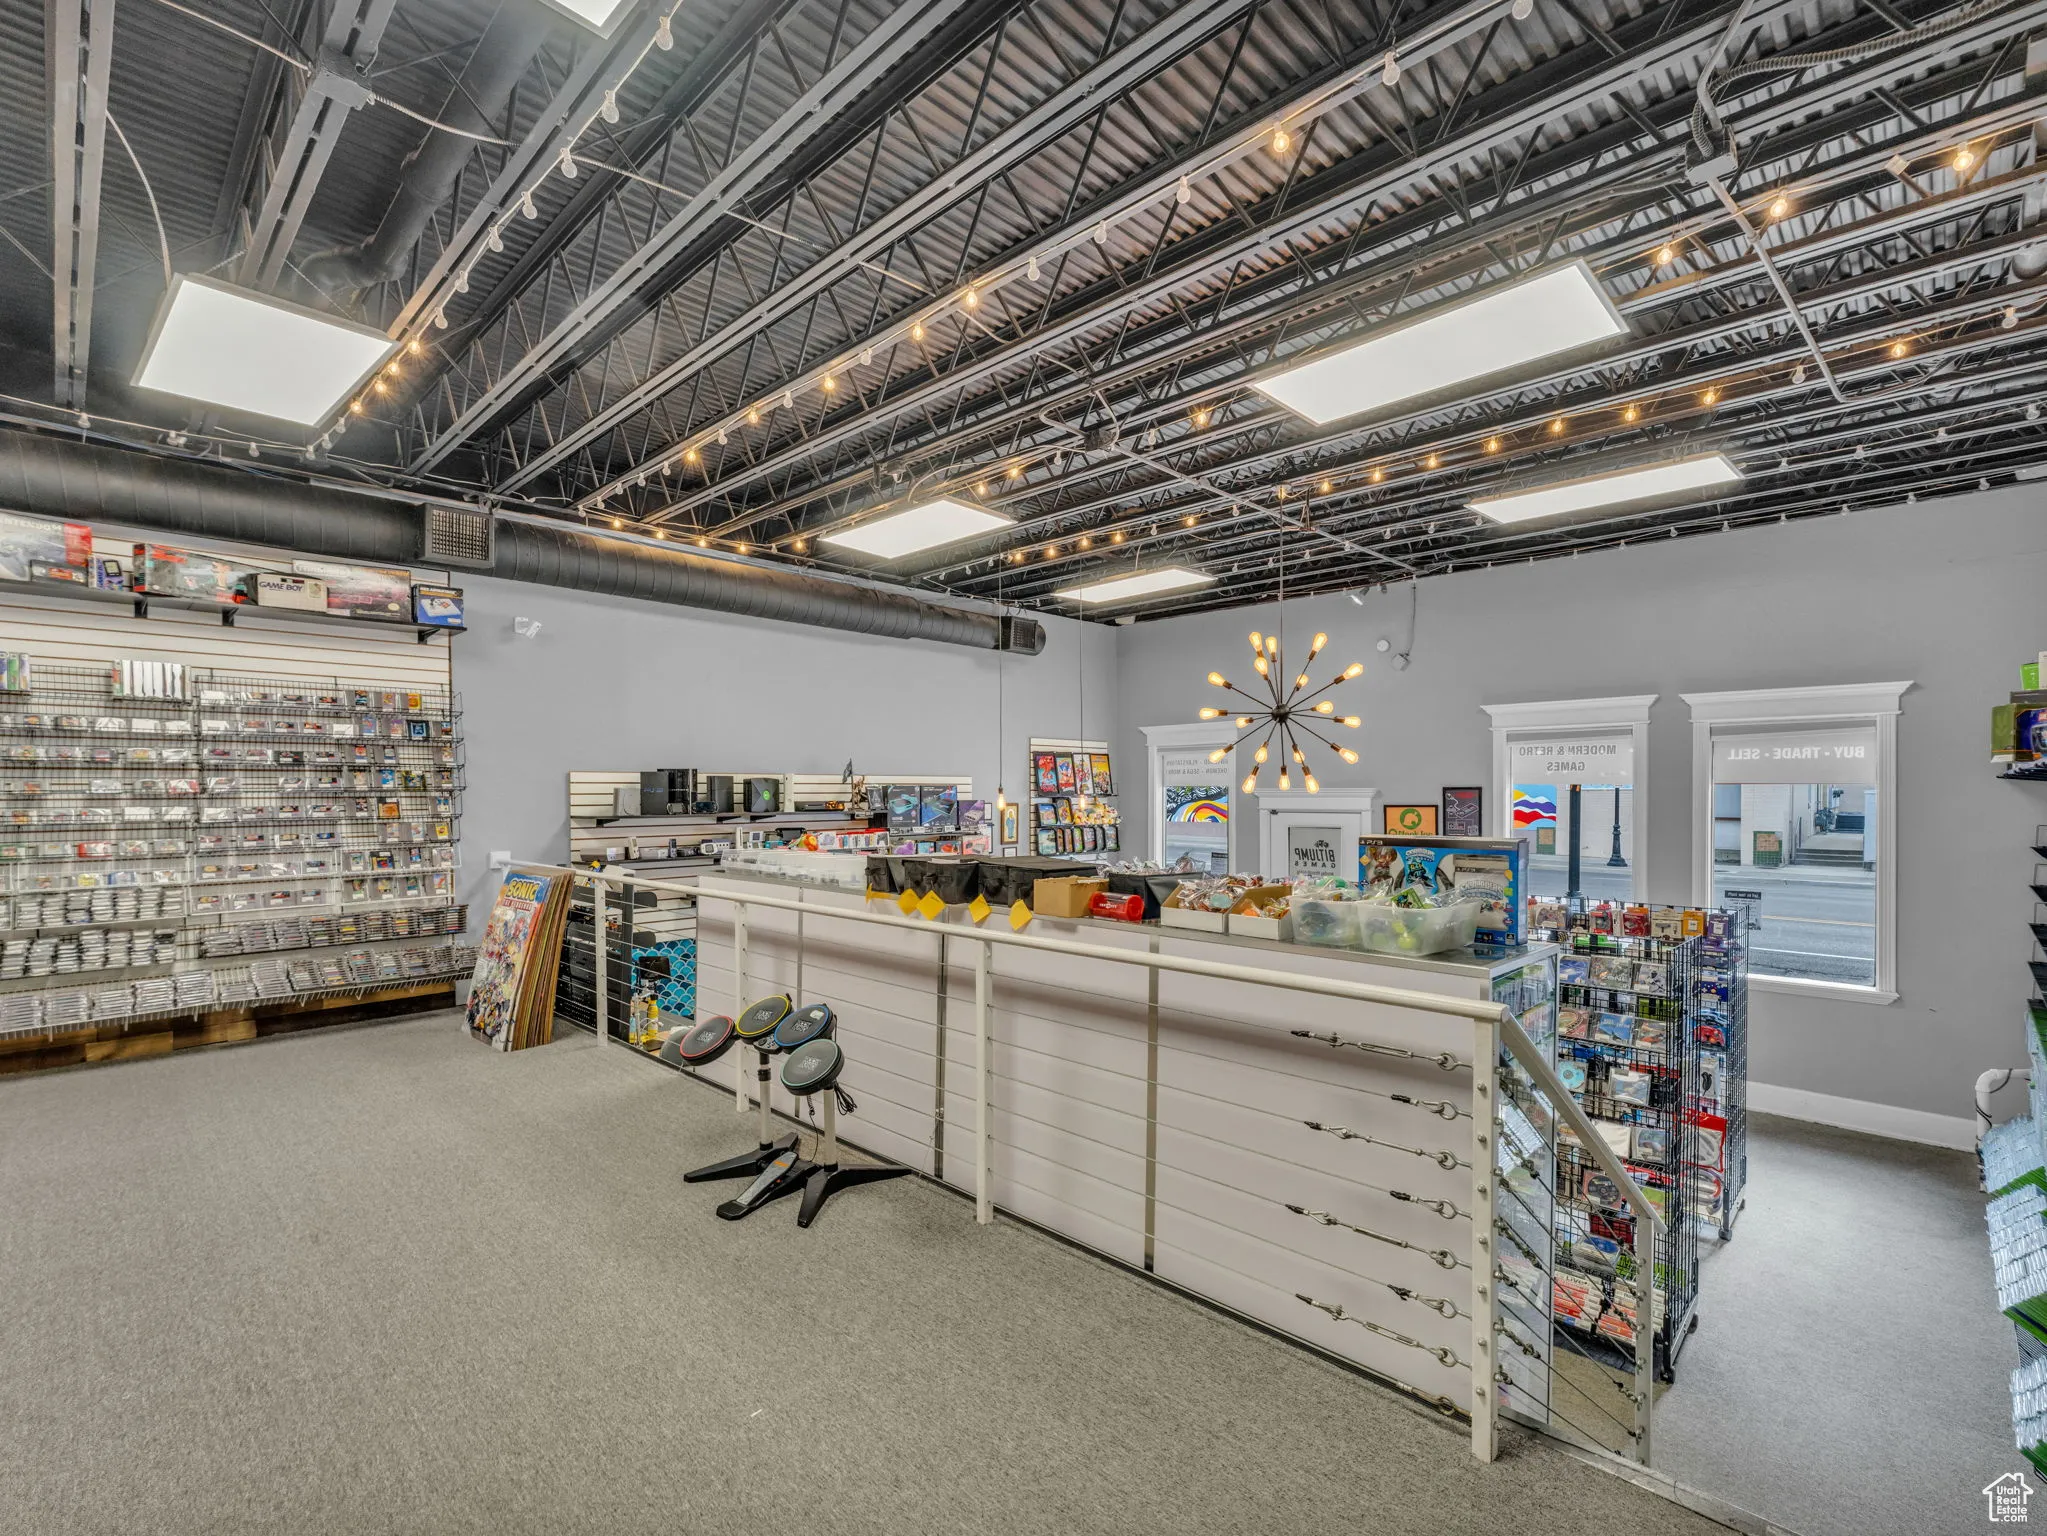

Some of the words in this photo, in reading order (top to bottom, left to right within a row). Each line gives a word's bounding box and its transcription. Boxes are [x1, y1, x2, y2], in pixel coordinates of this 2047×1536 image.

[258, 581, 285, 590] GAME
[286, 584, 303, 592] BOY
[505, 879, 541, 901] SONIC
